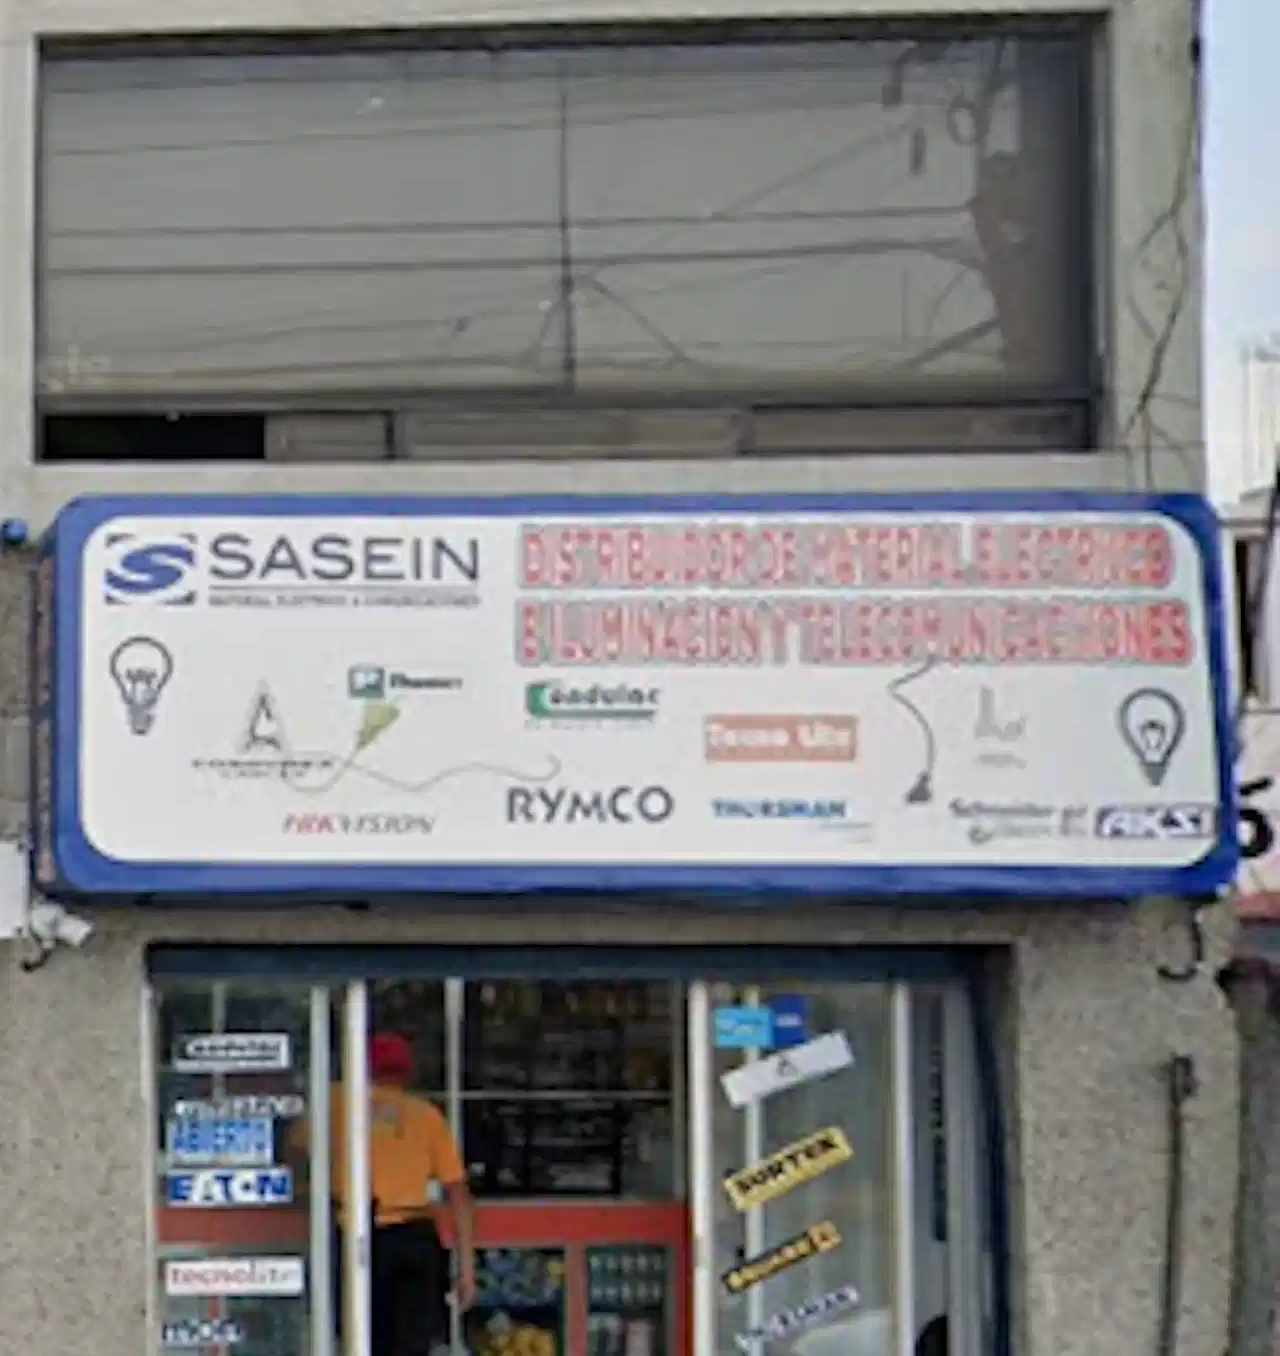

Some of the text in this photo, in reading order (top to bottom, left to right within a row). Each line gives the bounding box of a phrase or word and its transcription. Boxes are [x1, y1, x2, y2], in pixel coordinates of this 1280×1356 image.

[208, 532, 480, 581] SASEIN
[519, 526, 751, 588] DISTRIBUIDOR
[757, 526, 799, 588] DE
[807, 526, 965, 588] MATERIAL
[506, 786, 676, 824] RYMCO
[171, 1171, 290, 1203] EATON
